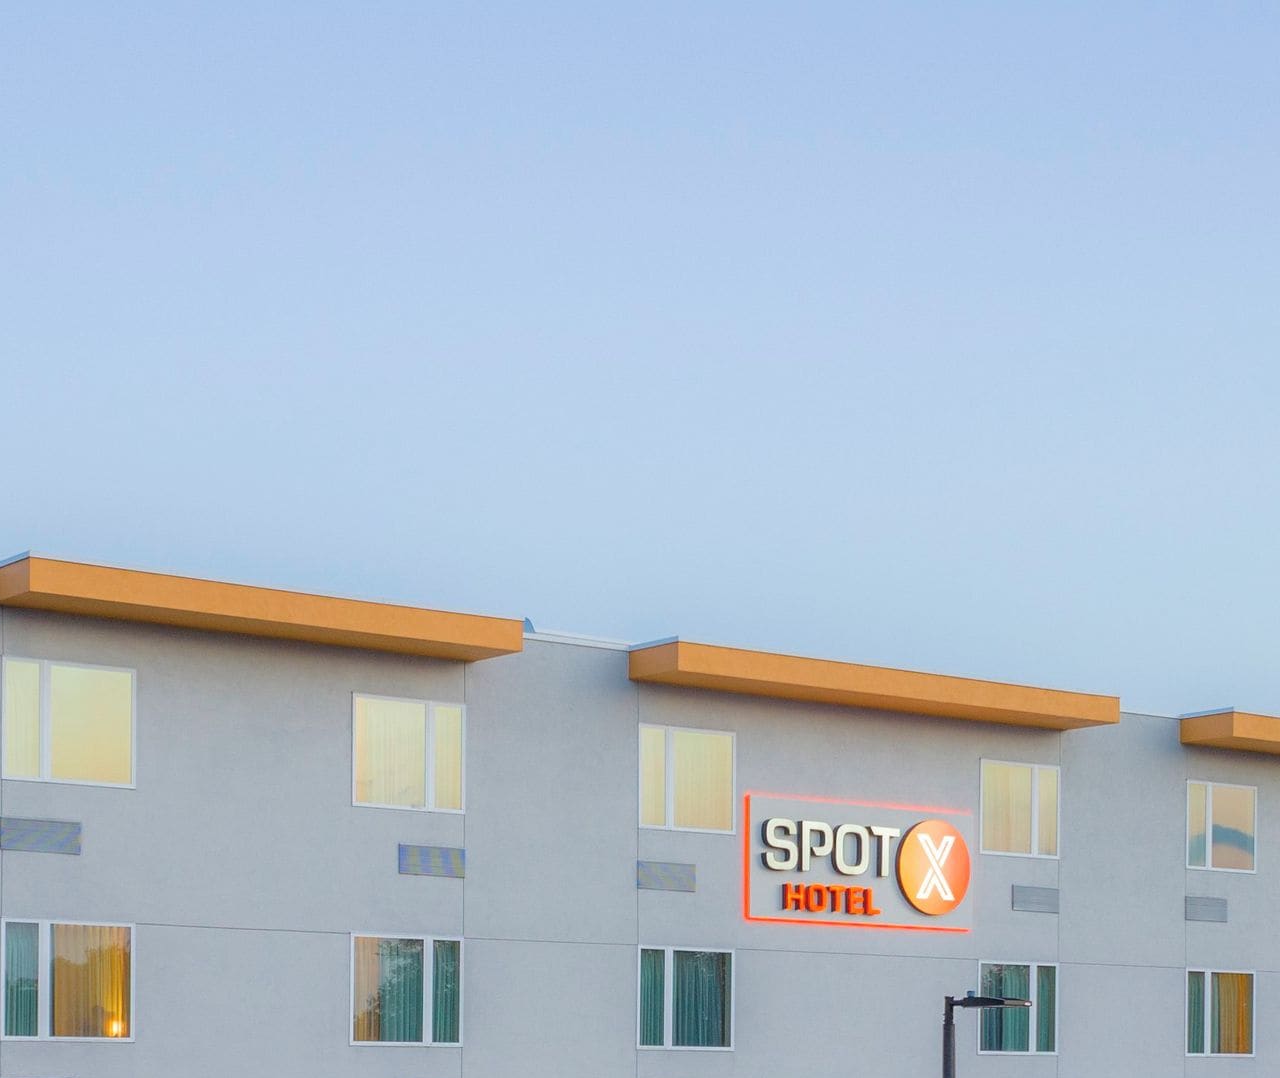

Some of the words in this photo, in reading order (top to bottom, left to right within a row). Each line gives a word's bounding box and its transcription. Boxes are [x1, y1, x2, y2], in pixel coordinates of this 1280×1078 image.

[762, 817, 901, 877] SPOT
[915, 832, 956, 901] X
[783, 882, 882, 915] HOTEL
